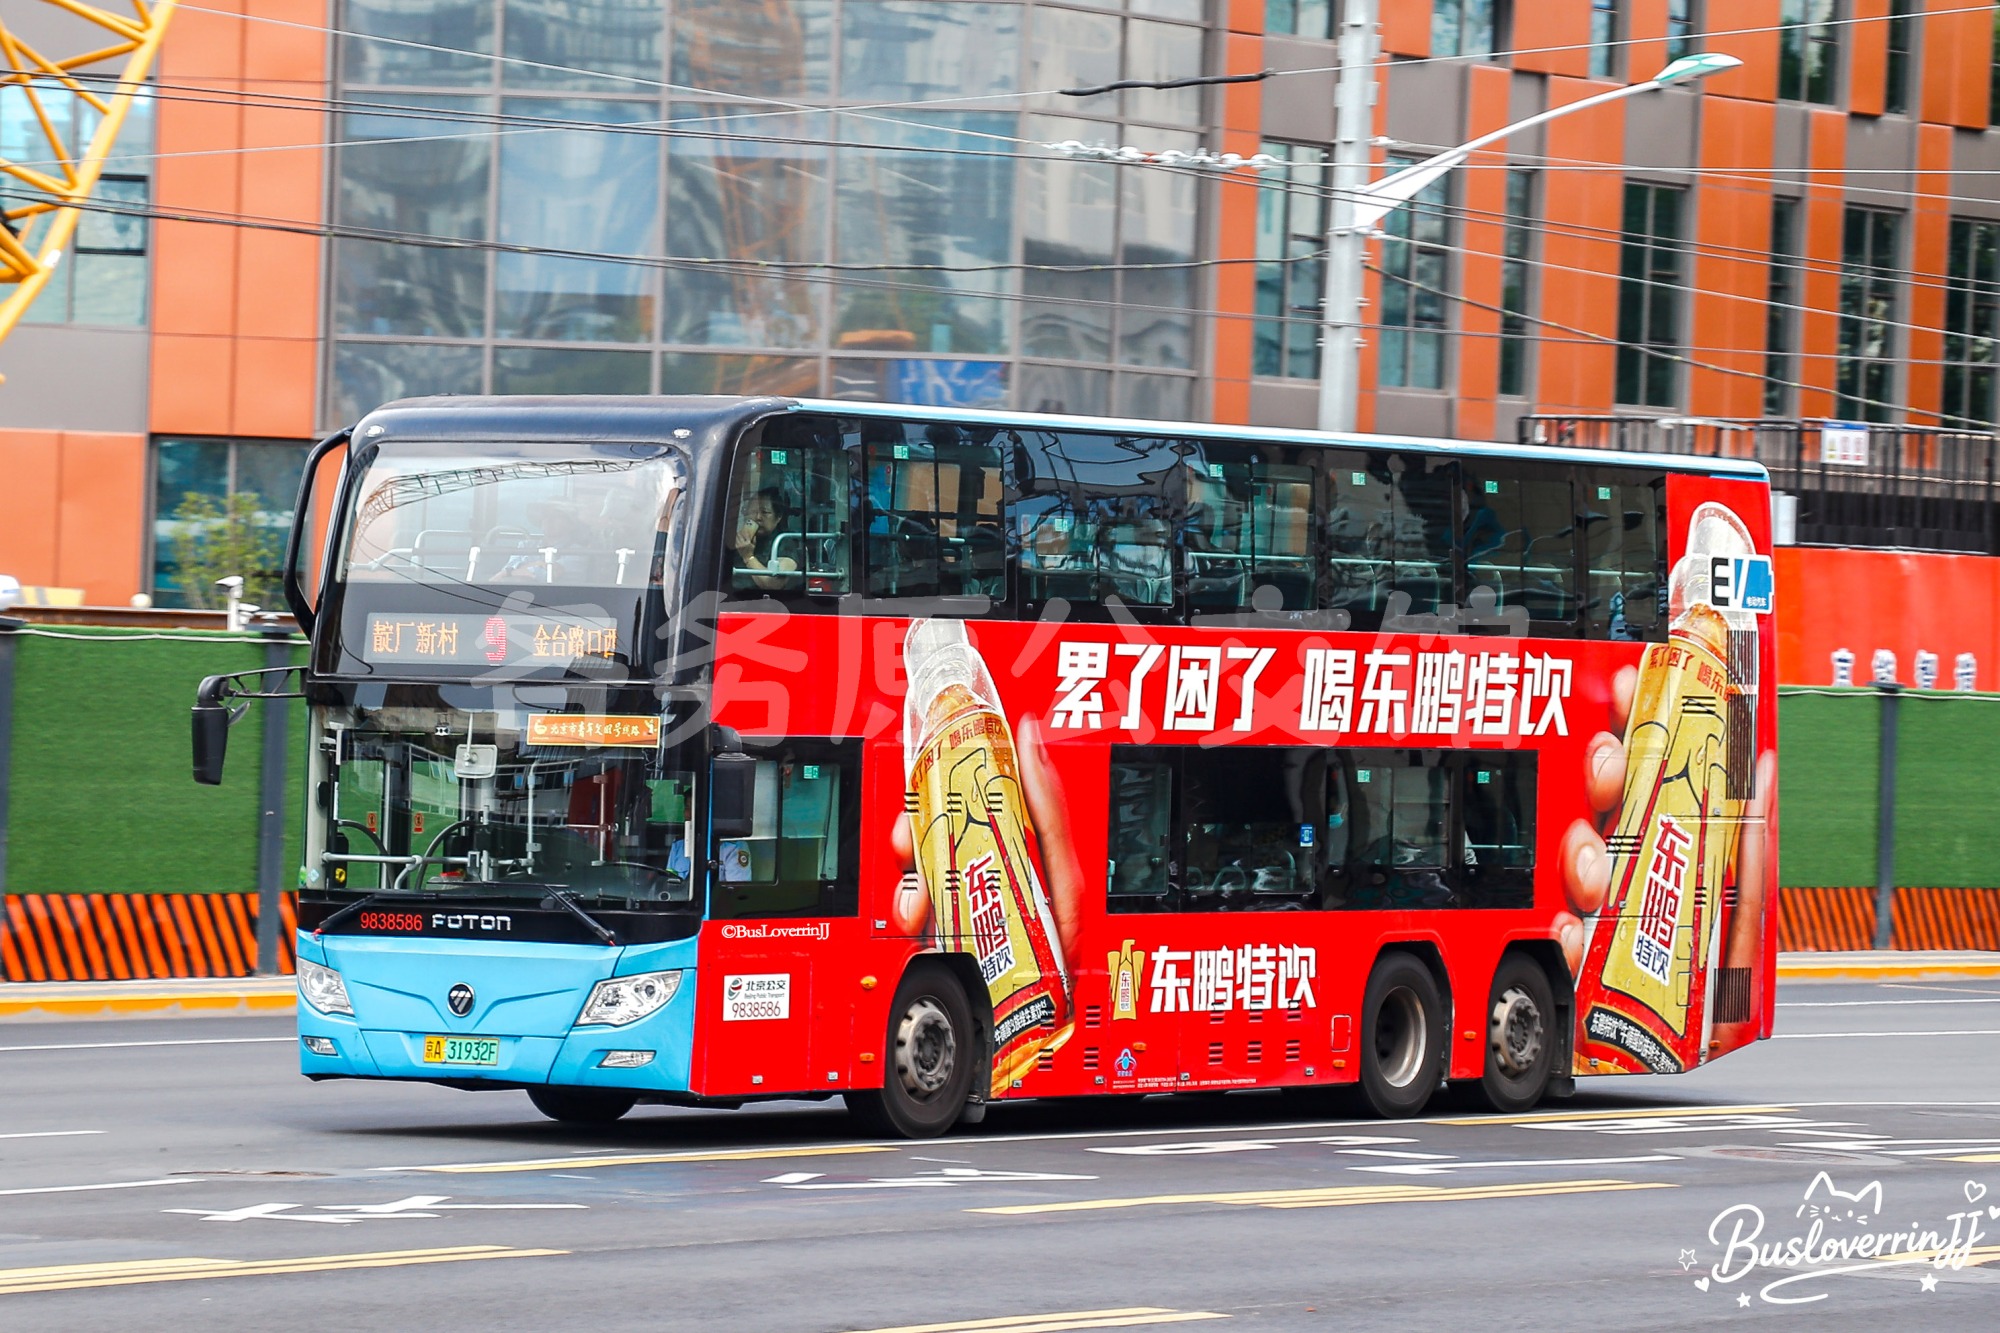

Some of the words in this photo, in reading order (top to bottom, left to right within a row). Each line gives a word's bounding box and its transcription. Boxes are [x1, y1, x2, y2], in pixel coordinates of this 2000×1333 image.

[372, 620, 459, 656] 靛厂新村
[485, 617, 507, 661] 9
[1050, 641, 1278, 732] 累了困了
[1299, 649, 1573, 736] 喝东鹏特饮
[360, 912, 423, 931] 9838586
[432, 913, 511, 931] FOTON
[745, 980, 786, 992] 北京公交
[1150, 943, 1317, 1013] 东鹏特饮
[731, 1001, 781, 1018] 9838586
[426, 1041, 442, 1058] 京A
[448, 1041, 498, 1061] 31932F
